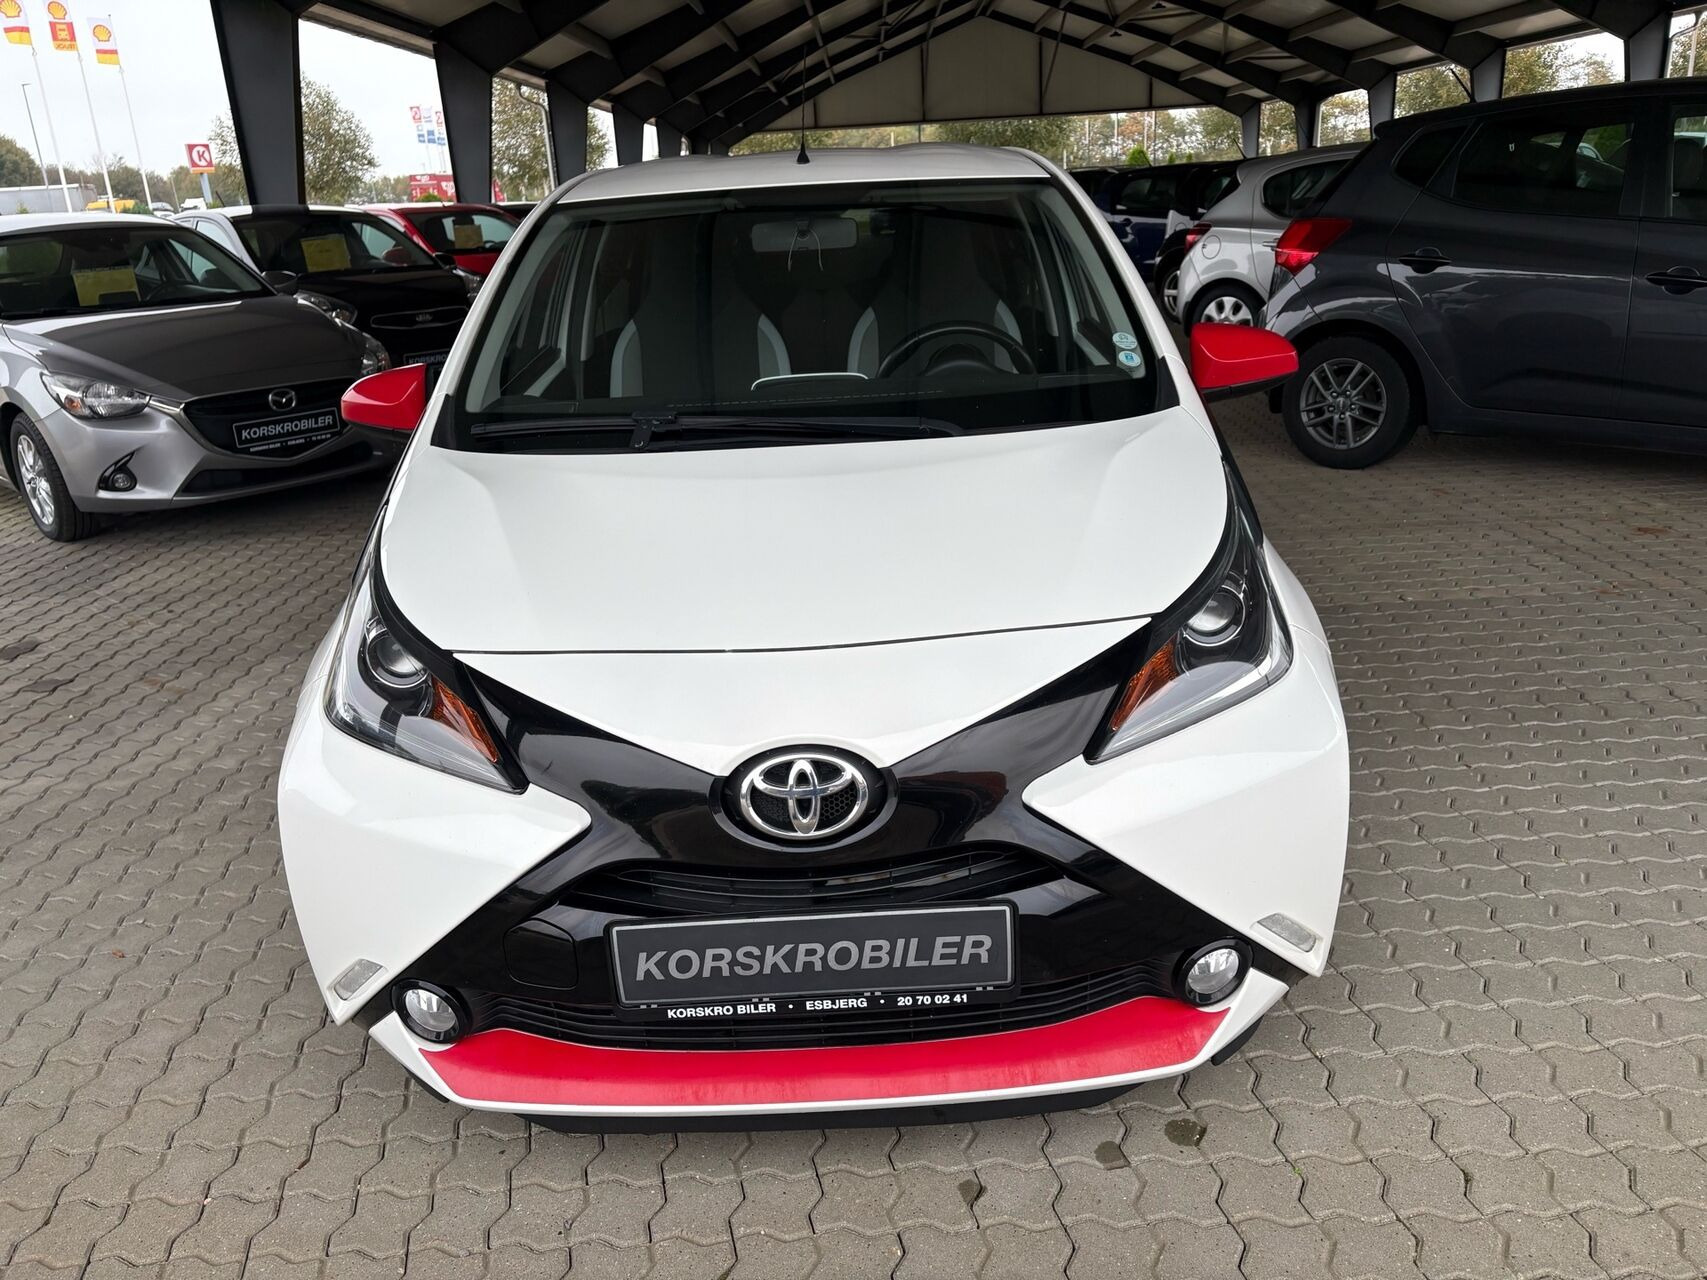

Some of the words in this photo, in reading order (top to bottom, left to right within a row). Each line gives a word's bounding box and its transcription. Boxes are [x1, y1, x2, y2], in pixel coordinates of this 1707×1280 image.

[197, 150, 208, 164] K
[241, 415, 333, 440] KORSKROBILER
[636, 934, 993, 981] KORSKROBILER
[667, 1005, 734, 1019] KORSKRO
[737, 1003, 776, 1015] BILER
[805, 998, 868, 1011] ESBJERG
[897, 996, 913, 1006] 20
[916, 995, 932, 1005] 70
[935, 994, 950, 1004] 02
[953, 993, 968, 1003] 41
